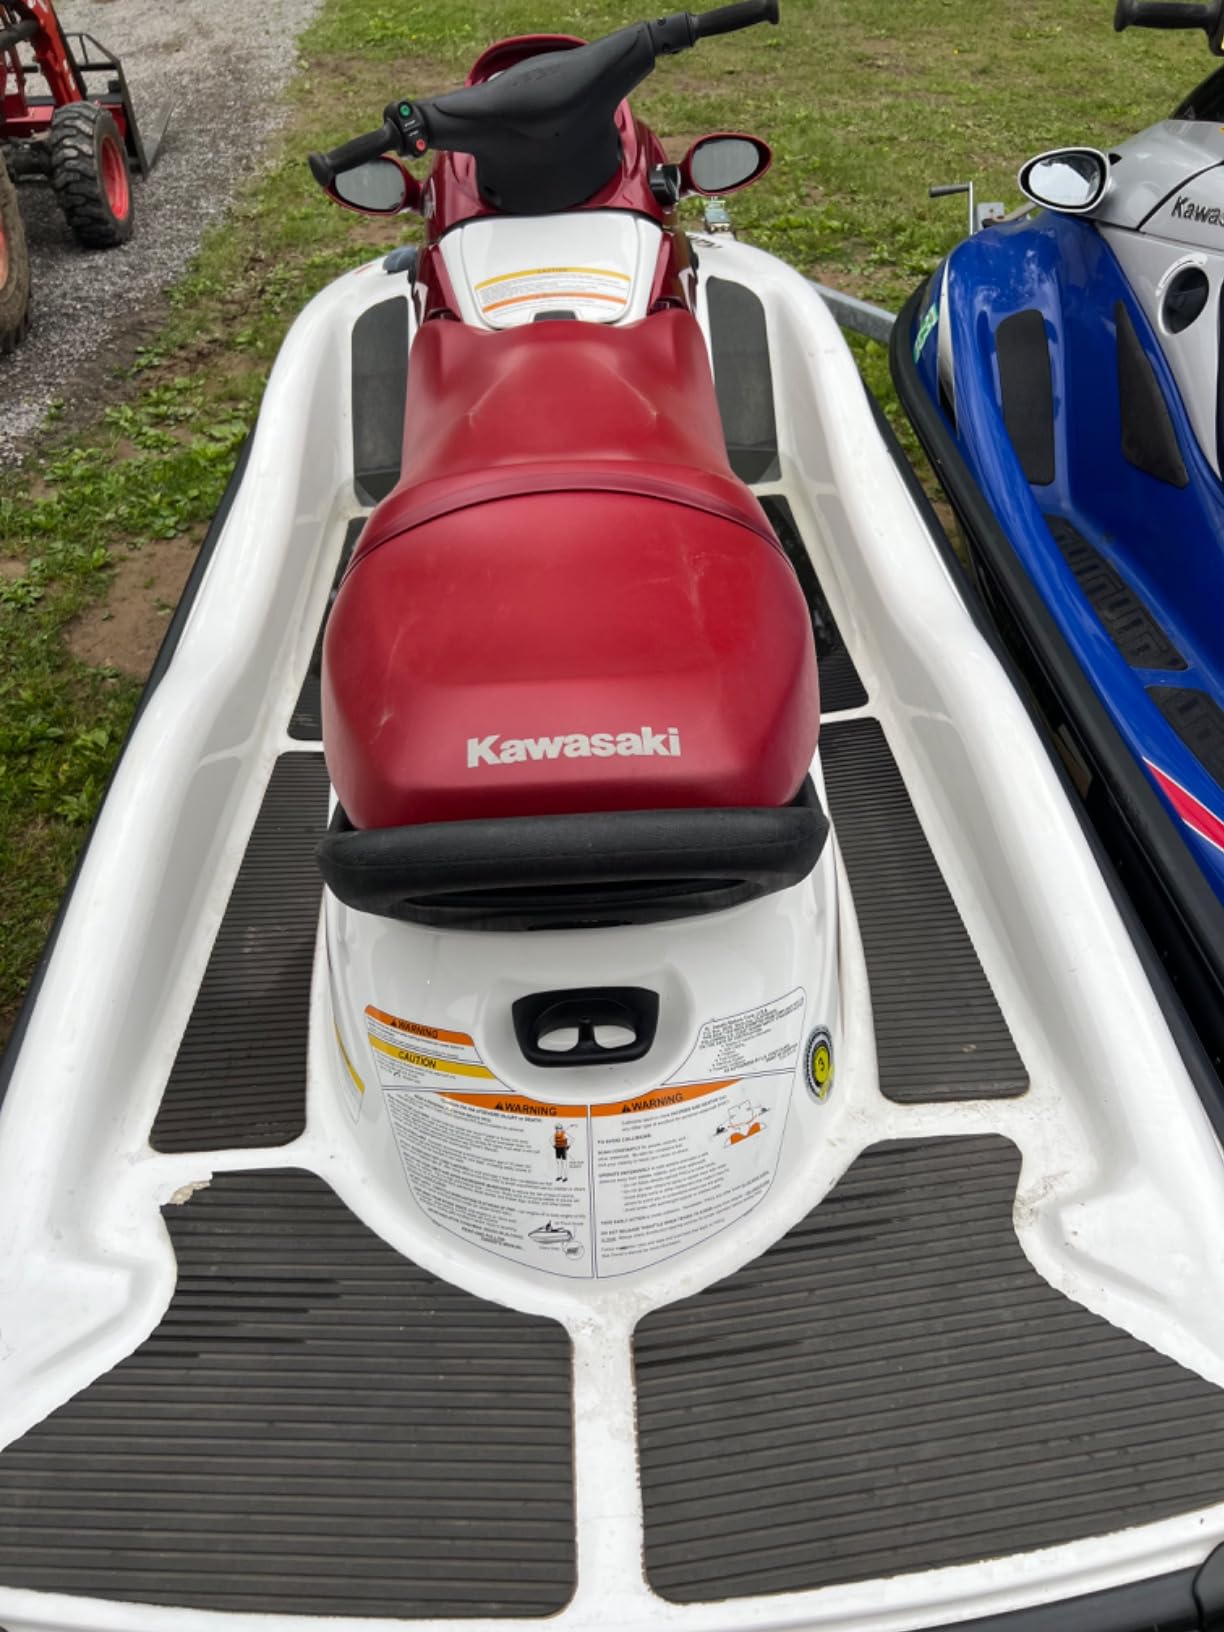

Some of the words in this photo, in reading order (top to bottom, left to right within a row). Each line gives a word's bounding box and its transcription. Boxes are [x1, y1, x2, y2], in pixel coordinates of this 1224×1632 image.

[1171, 196, 1224, 227] Kawa
[467, 727, 681, 768] Kawasaki
[399, 1020, 438, 1039] WARNING
[398, 1051, 436, 1068] CAUTION
[505, 1103, 557, 1116] WARNING
[631, 1093, 684, 1111] WARNING
